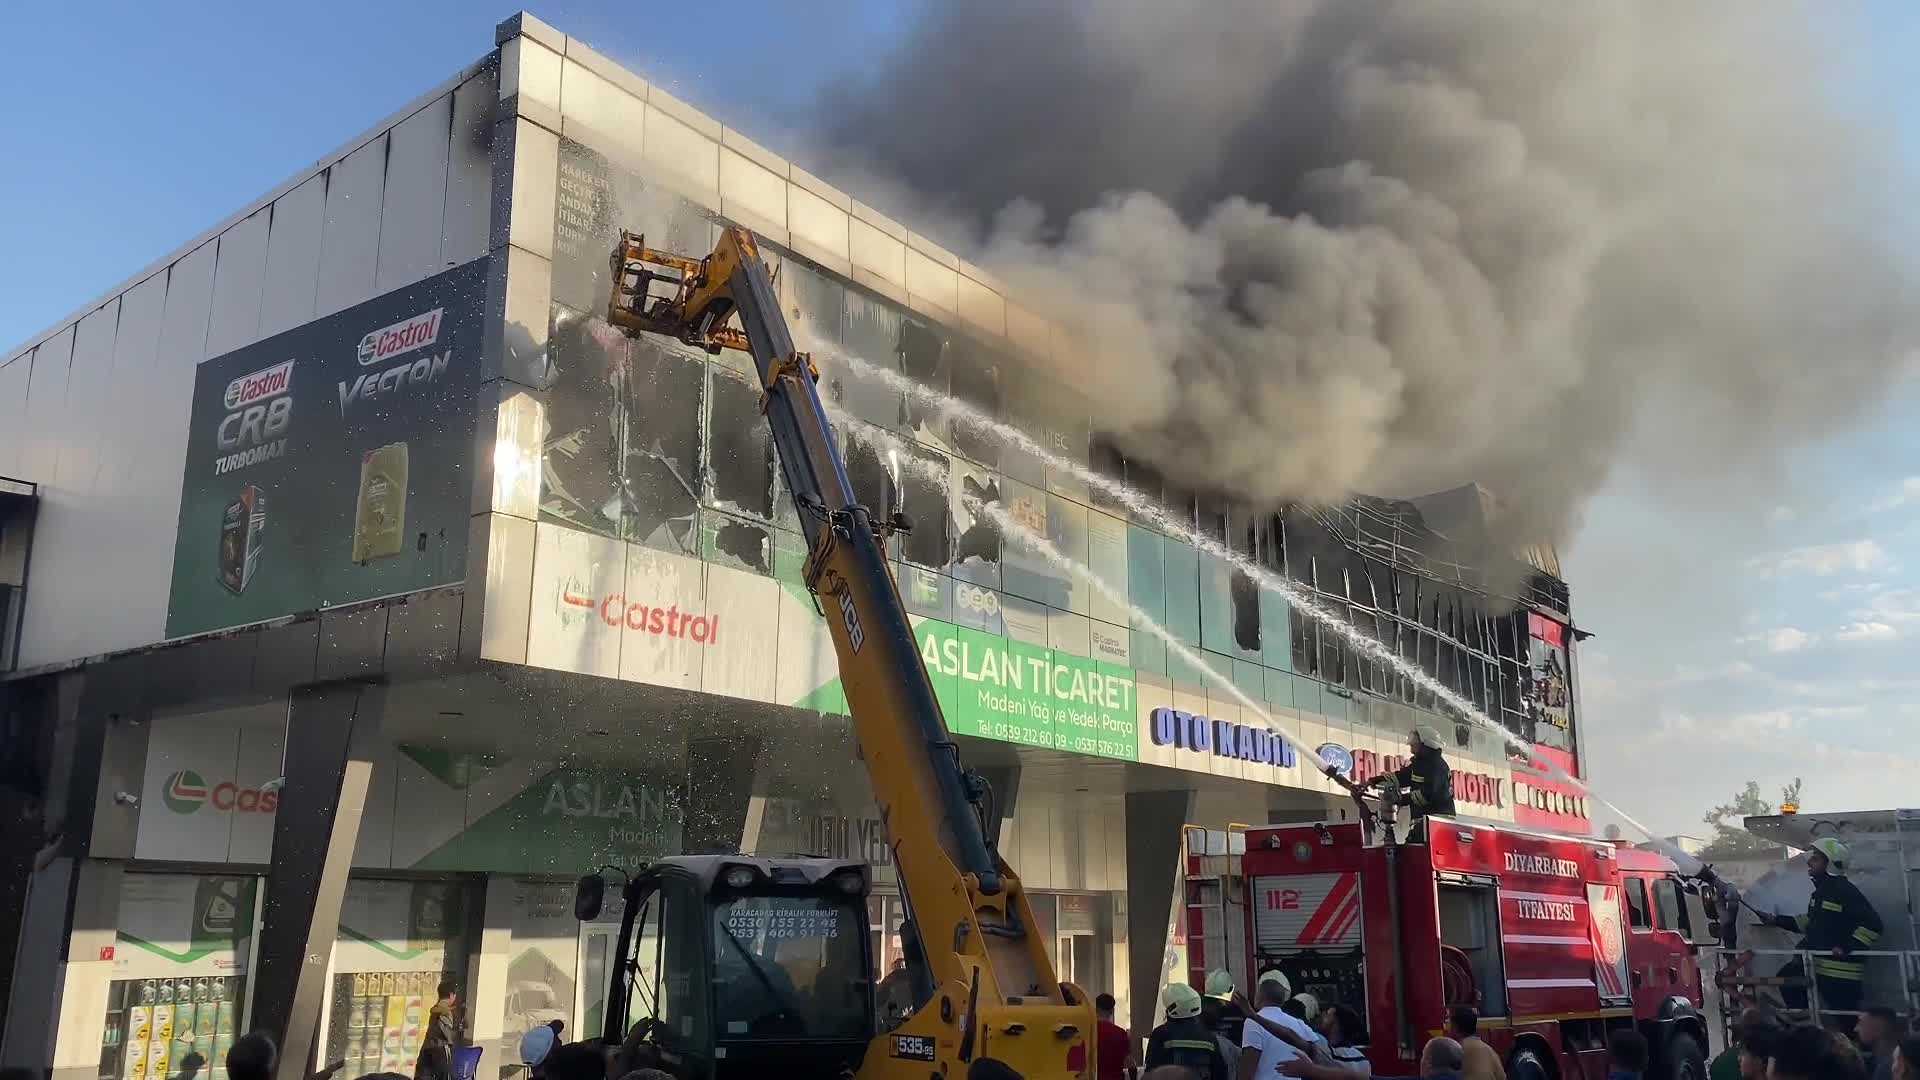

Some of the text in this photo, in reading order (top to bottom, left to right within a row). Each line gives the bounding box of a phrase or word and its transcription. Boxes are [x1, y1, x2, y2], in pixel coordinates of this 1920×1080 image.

[376, 314, 437, 357] Castrol
[240, 366, 288, 401] Castrol
[338, 350, 452, 417] VECTON
[217, 396, 293, 450] CRB
[215, 438, 288, 475] TURBOMAX
[601, 592, 718, 645] Castrol
[838, 582, 865, 656] JCB
[921, 633, 1134, 711] ASLAN TİCARET
[978, 690, 1133, 738] Madeni Yağ ve Yedek Parça
[1152, 707, 1211, 752] OTO
[1023, 727, 1038, 743] 212
[1040, 730, 1052, 746] 60
[1054, 733, 1067, 747] 09
[1075, 737, 1097, 752] 0537
[1504, 849, 1580, 879] DİYARBAKIR
[1266, 889, 1299, 911] 112
[1518, 898, 1576, 922] İTFAİYESİ
[728, 918, 763, 929] 0530
[770, 918, 795, 928] 155
[800, 918, 816, 928] 22
